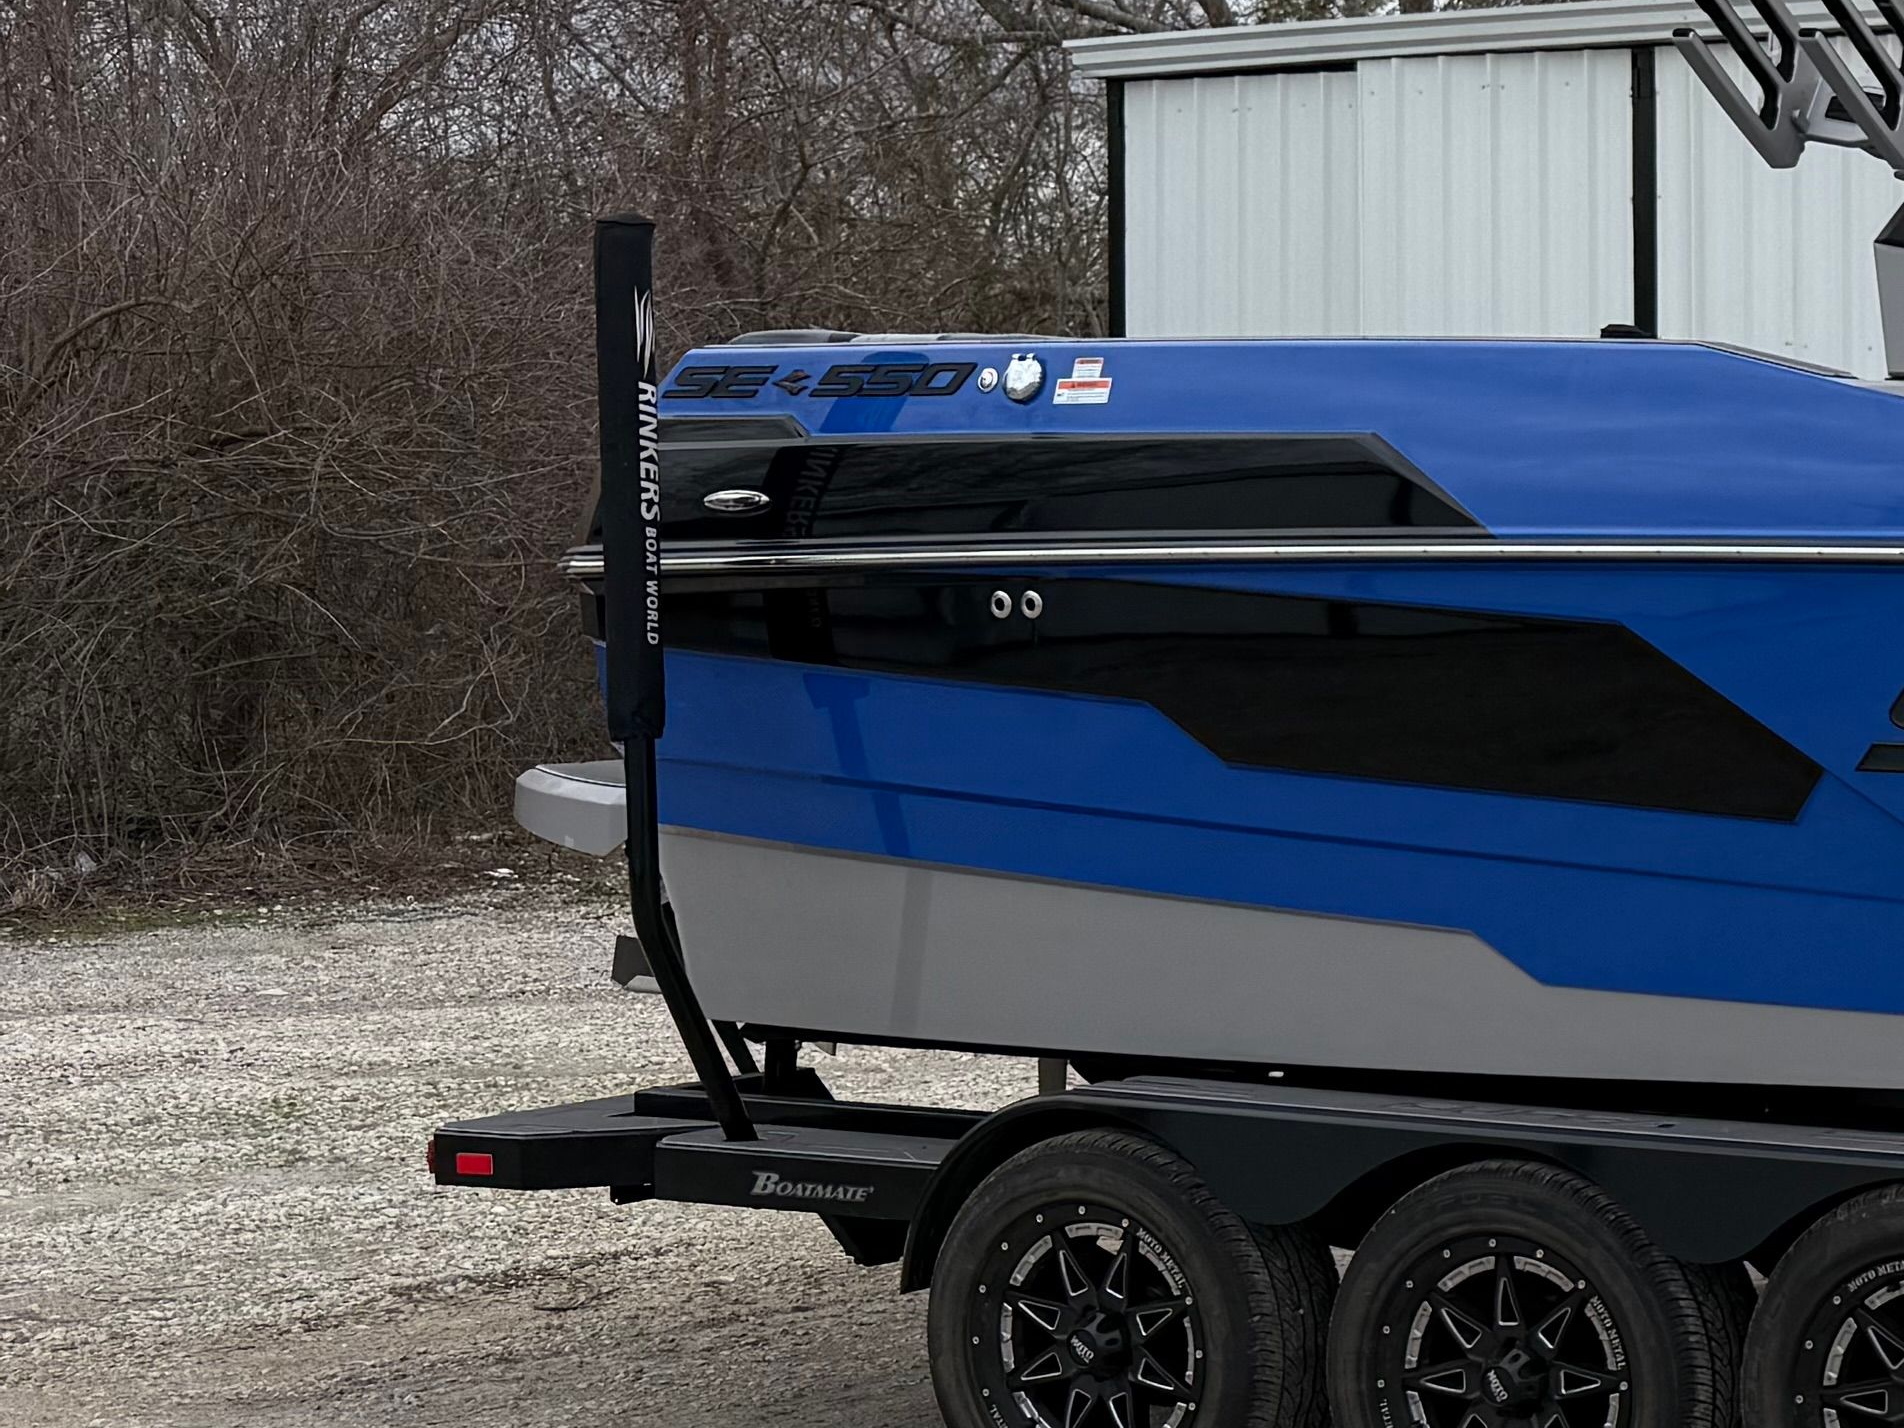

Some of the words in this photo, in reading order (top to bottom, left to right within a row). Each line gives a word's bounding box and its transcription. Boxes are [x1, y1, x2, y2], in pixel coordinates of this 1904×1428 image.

[660, 364, 779, 400] SE
[807, 361, 979, 398] 550
[638, 380, 660, 522] RINKERS
[645, 526, 658, 575] BOAT
[646, 580, 659, 646] WORLD
[1847, 1269, 1877, 1293] MOTO
